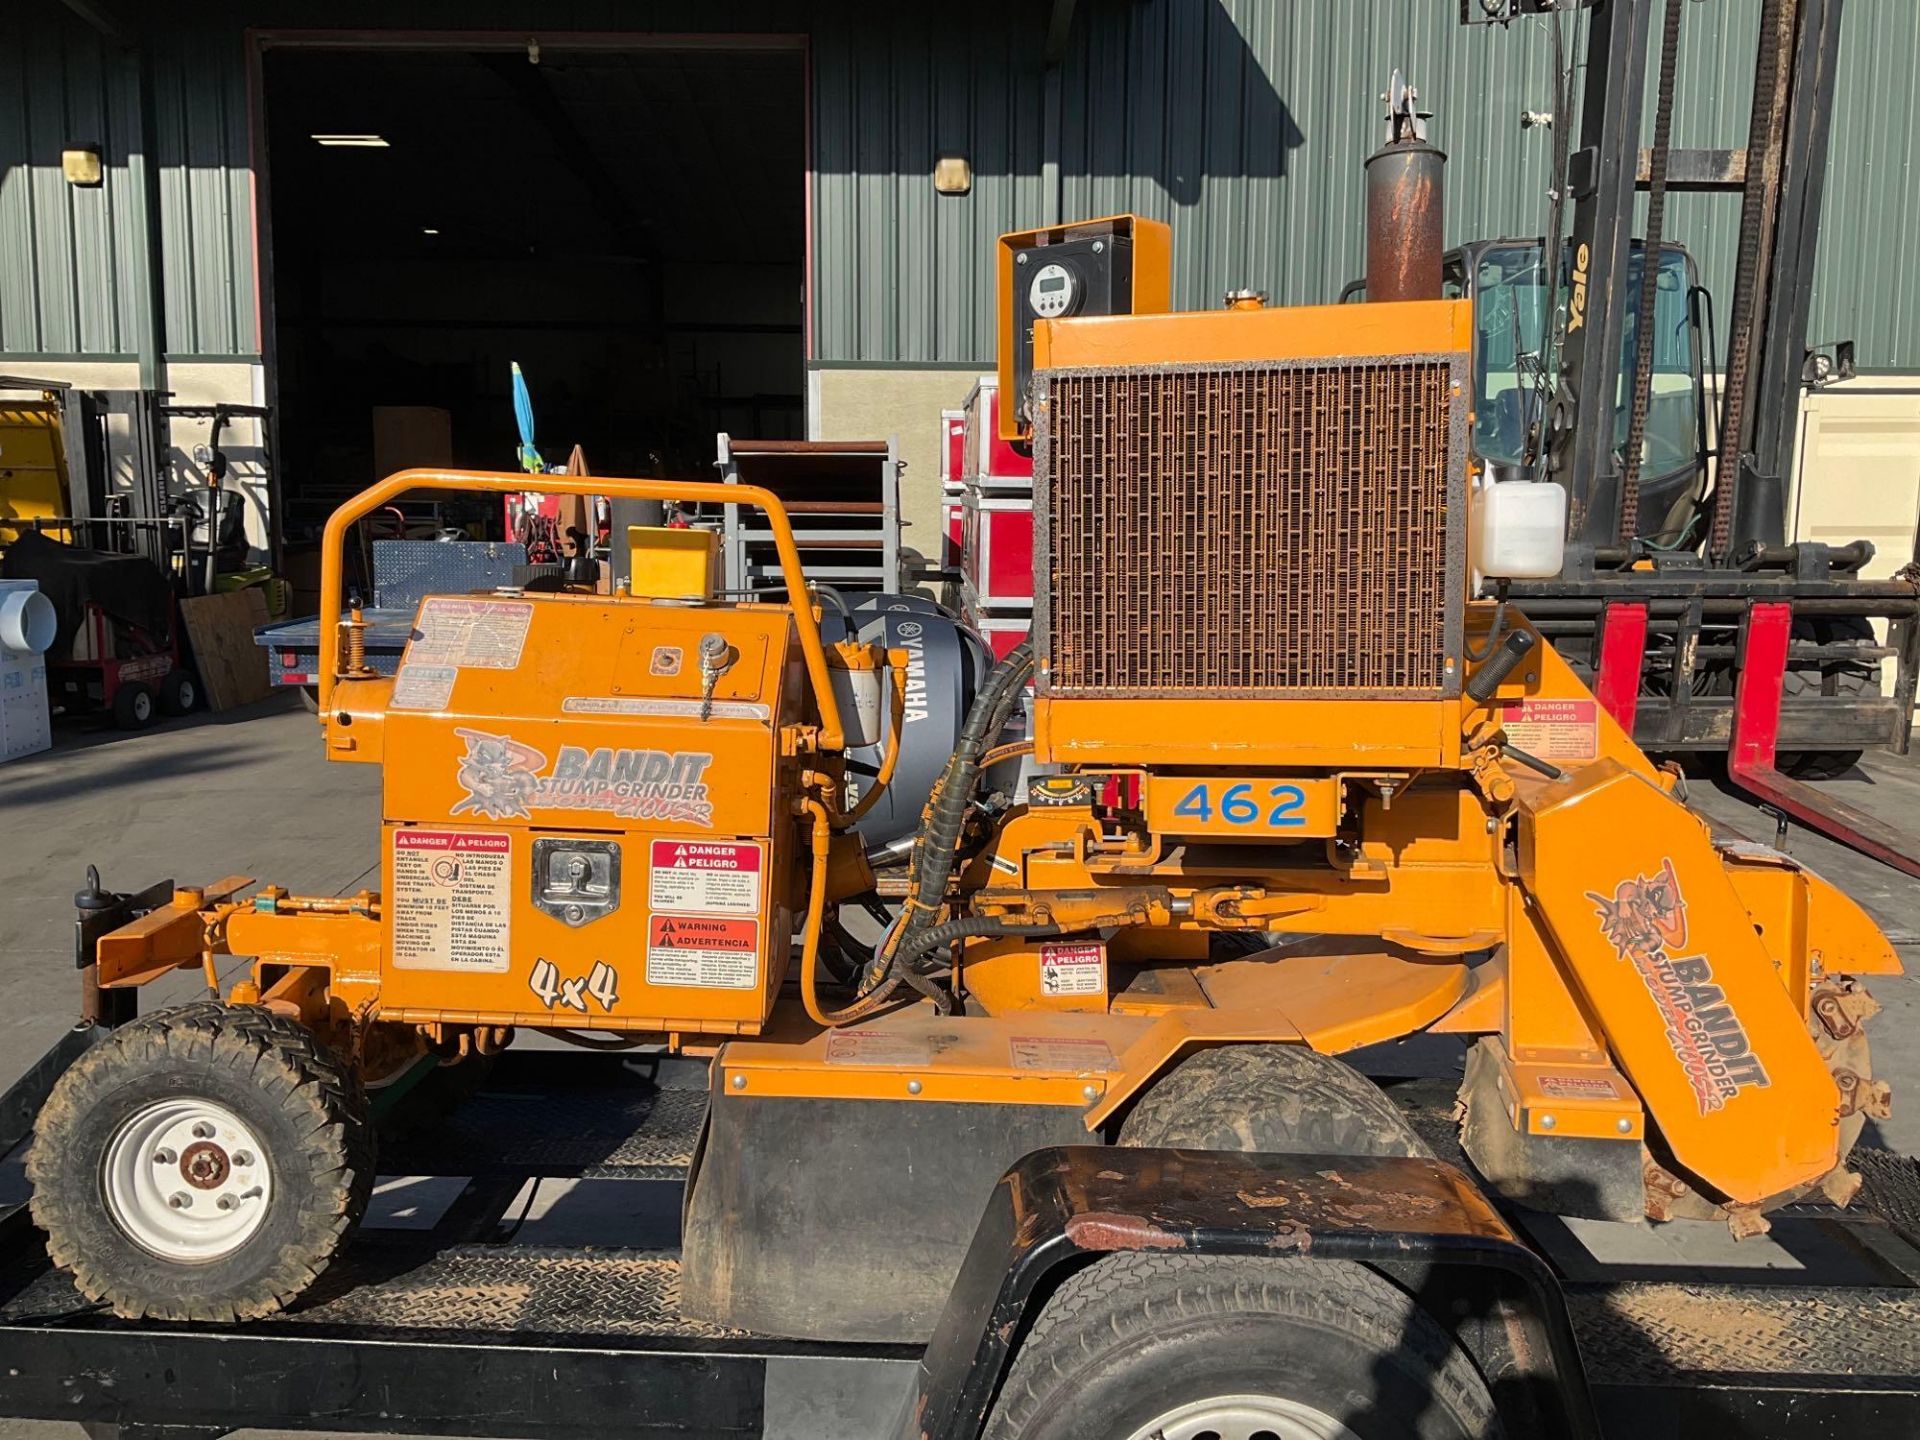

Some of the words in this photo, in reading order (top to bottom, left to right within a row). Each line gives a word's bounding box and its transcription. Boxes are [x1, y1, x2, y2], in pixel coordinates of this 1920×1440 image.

[1568, 244, 1588, 334] Yale
[900, 637, 928, 722] YAMAHA
[555, 747, 711, 784] BANDIT
[537, 779, 609, 795] STUMP
[614, 782, 706, 800] GRINDER
[1174, 784, 1306, 826] 462
[689, 846, 736, 855] DANGER
[689, 858, 737, 868] PELIGRO
[677, 938, 749, 947] ADVERTENCIA
[678, 922, 726, 932] WARNING
[528, 958, 620, 1013] 4x4
[1650, 950, 1692, 1016] STUMP
[1684, 1018, 1738, 1098] GRINDER
[1670, 957, 1769, 1087] BANDIT
